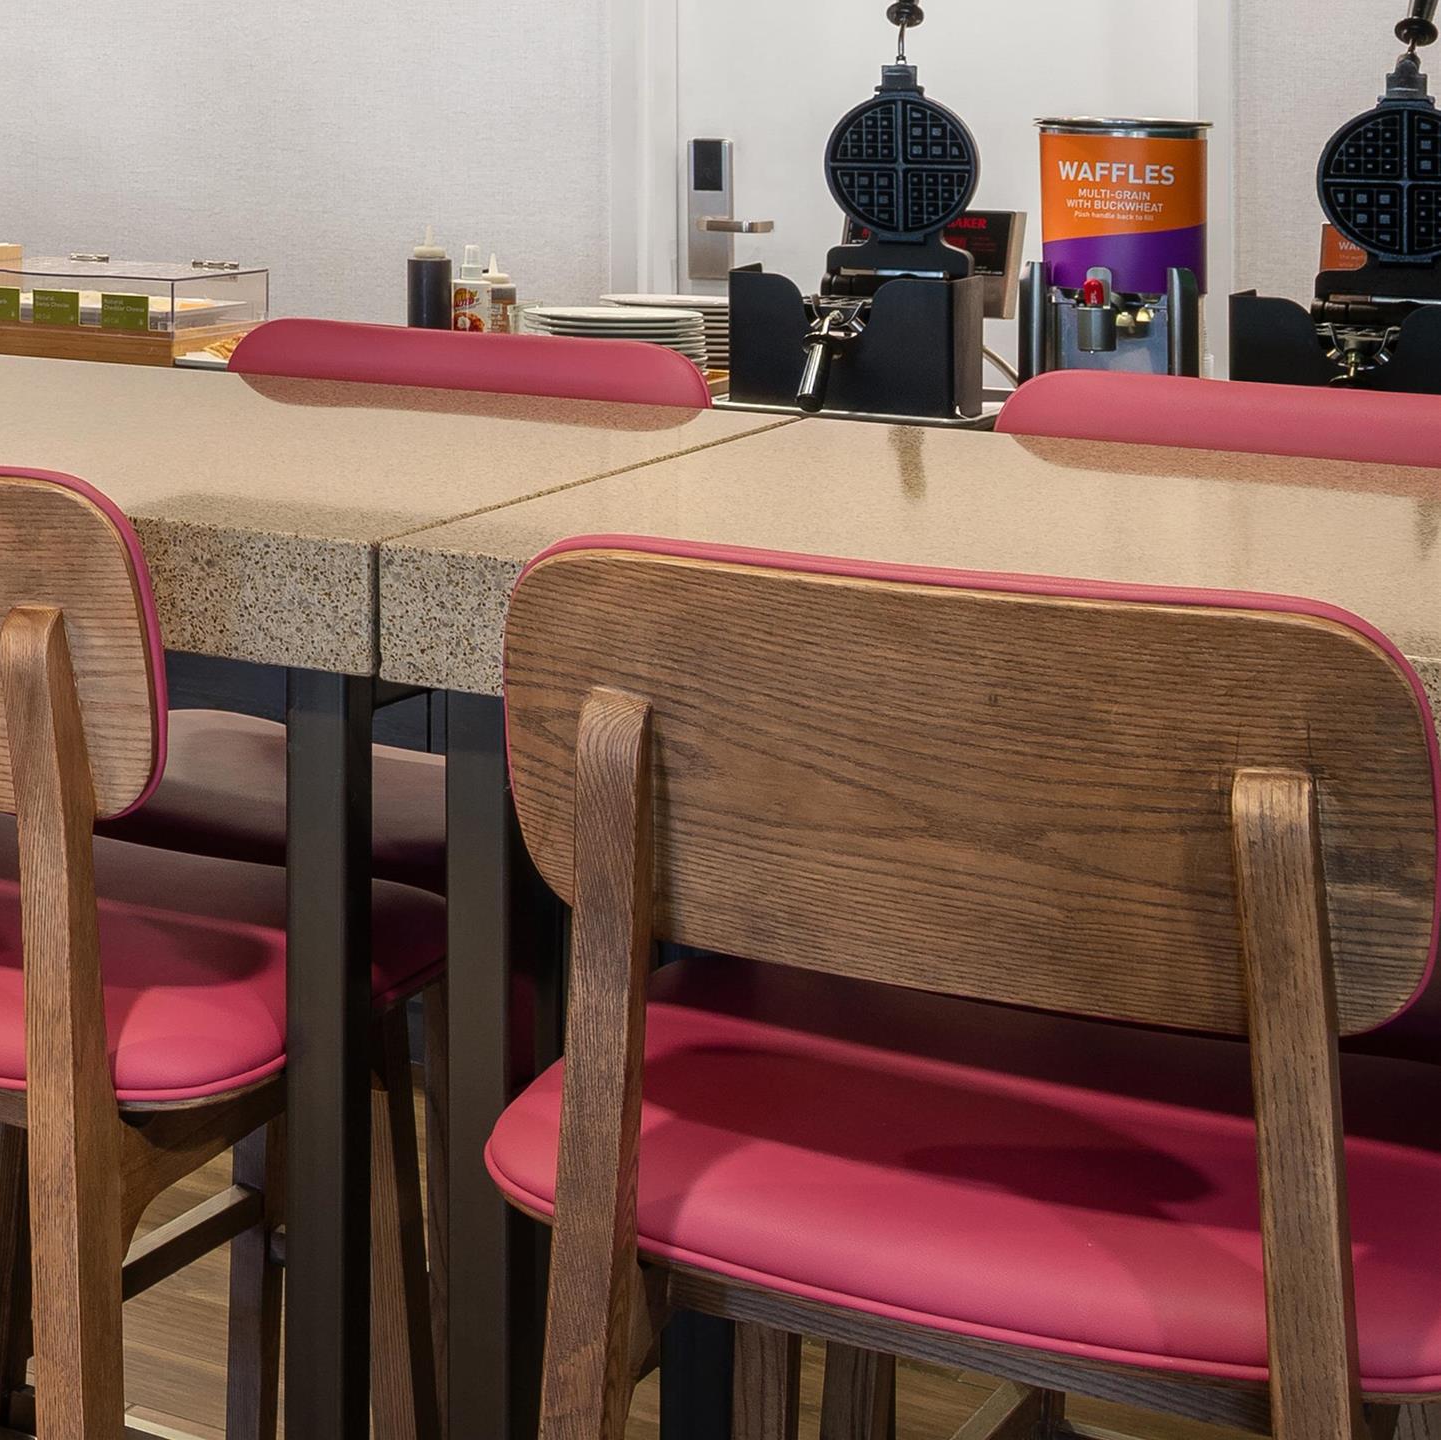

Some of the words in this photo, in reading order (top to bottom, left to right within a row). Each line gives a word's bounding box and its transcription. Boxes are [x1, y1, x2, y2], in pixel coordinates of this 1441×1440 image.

[1058, 160, 1175, 185] WAFFLES
[1078, 188, 1151, 201] MULTI-GRAIN
[1066, 198, 1091, 209] WITH
[1094, 199, 1164, 213] BUCKWHEAT
